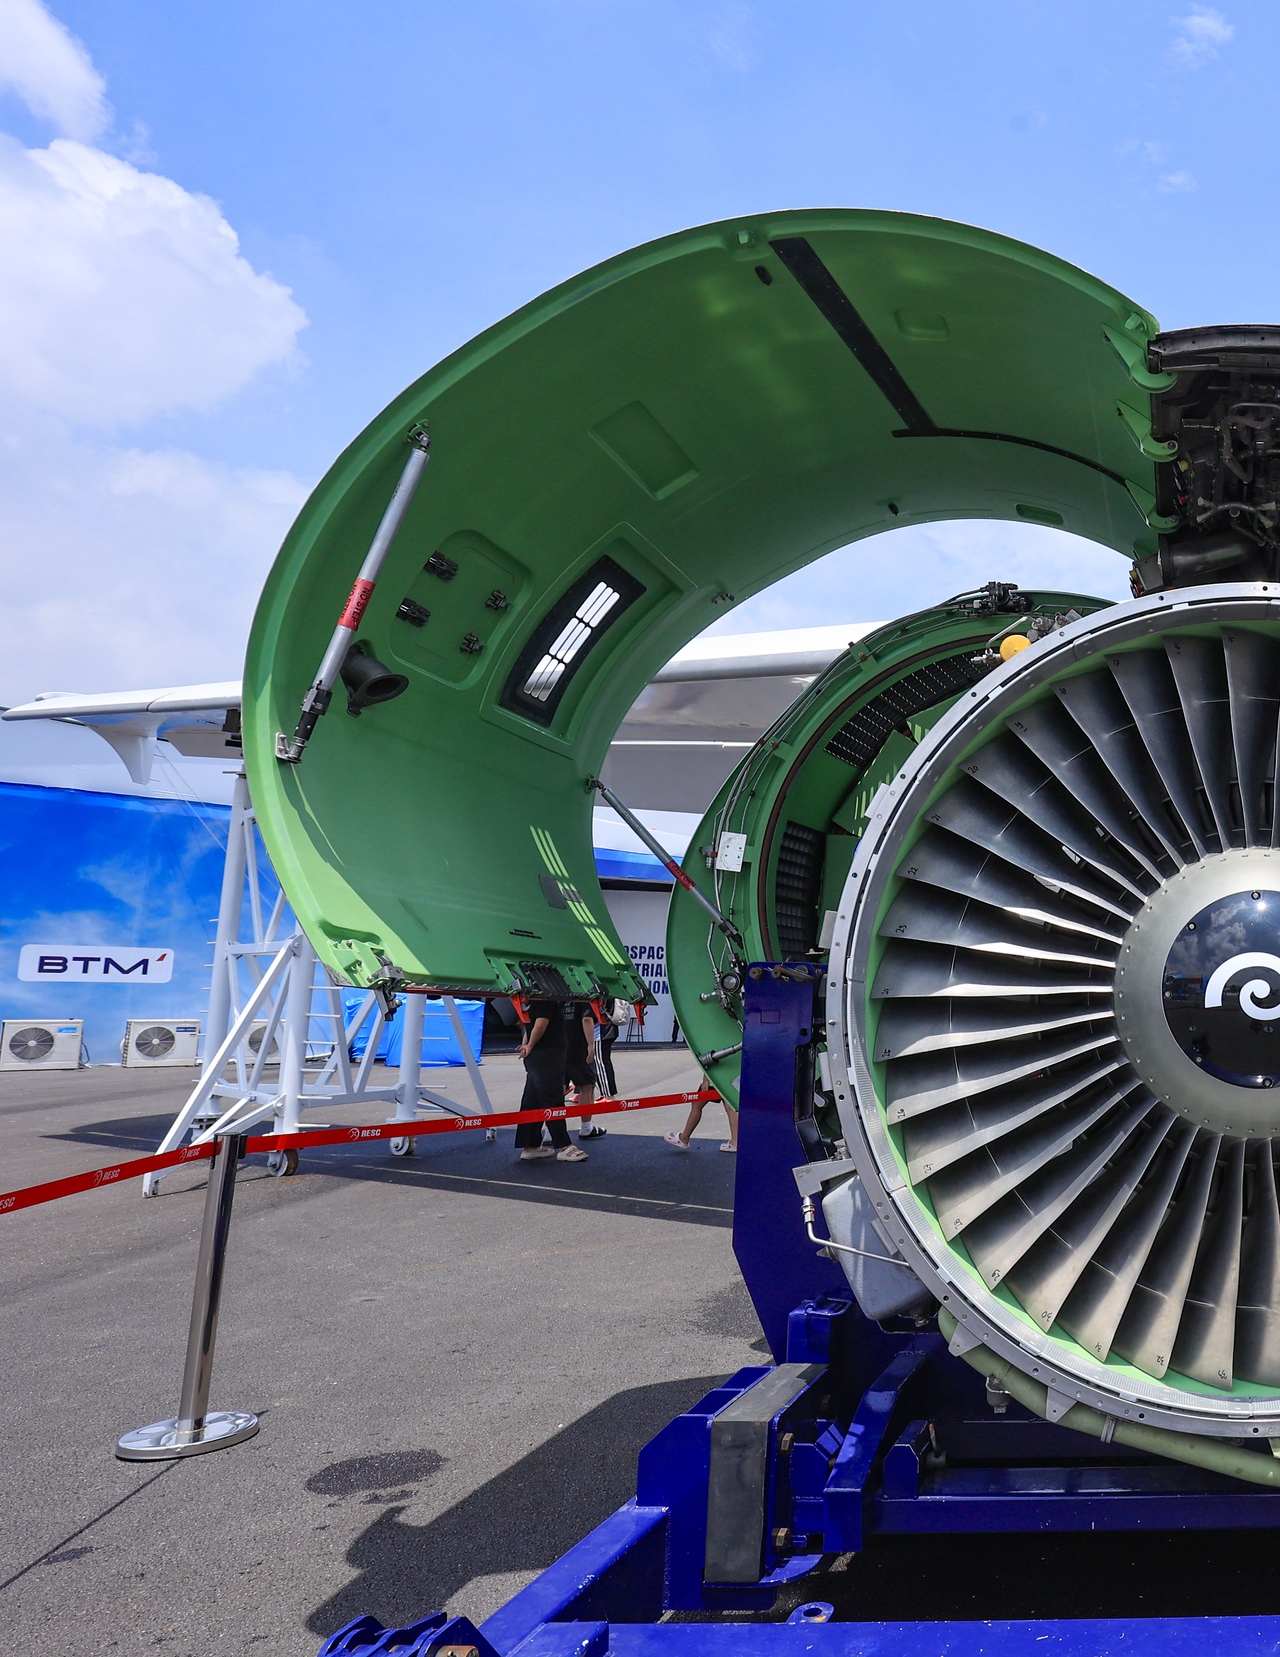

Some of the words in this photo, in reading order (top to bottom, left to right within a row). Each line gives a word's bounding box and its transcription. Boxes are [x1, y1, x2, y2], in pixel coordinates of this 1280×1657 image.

[360, 587, 370, 601] NO
[352, 601, 364, 623] STEP
[967, 765, 979, 774] 20
[907, 867, 918, 876] 22
[895, 924, 907, 933] 23
[38, 956, 149, 975] BTM
[897, 1108, 906, 1119] 26
[465, 1119, 482, 1127] AESC
[361, 1128, 381, 1137] AESC
[102, 1168, 121, 1181] AESC
[1041, 1310, 1053, 1322] 30
[1156, 1355, 1165, 1366] 32
